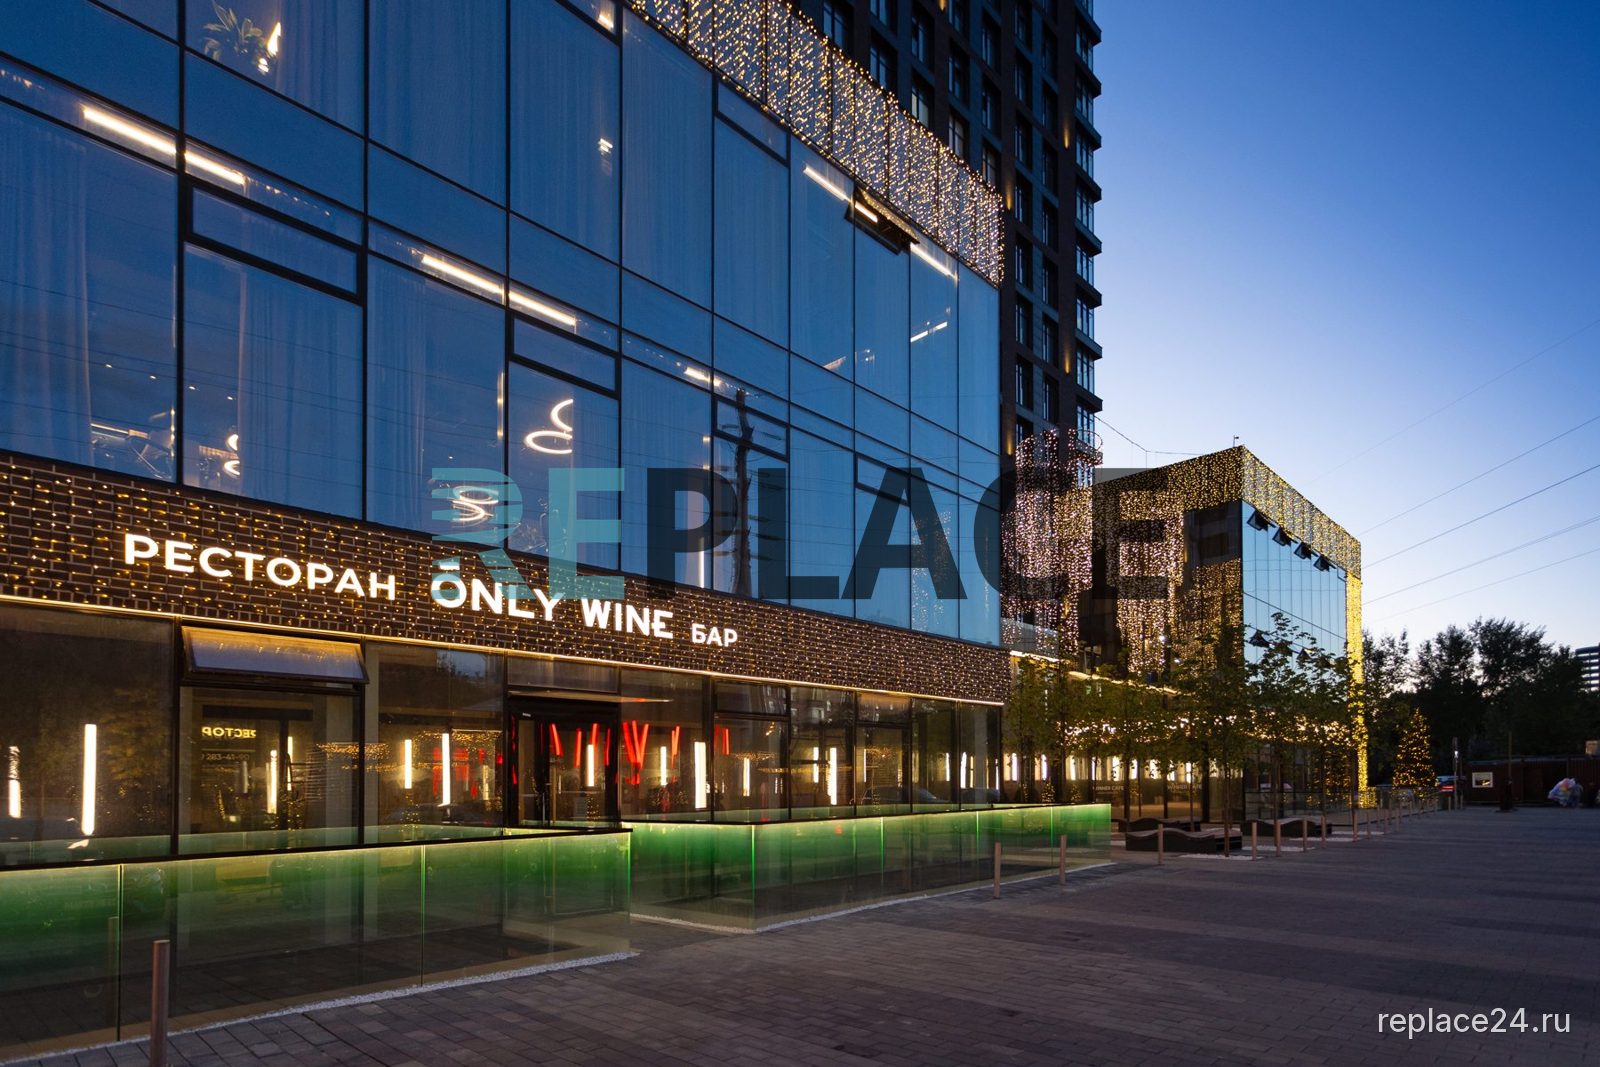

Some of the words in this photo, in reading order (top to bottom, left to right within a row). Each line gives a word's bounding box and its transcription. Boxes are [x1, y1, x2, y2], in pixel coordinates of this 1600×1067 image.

[124, 533, 396, 600] РЕСТОРАН
[580, 597, 674, 639] WINE
[690, 622, 738, 648] БАР
